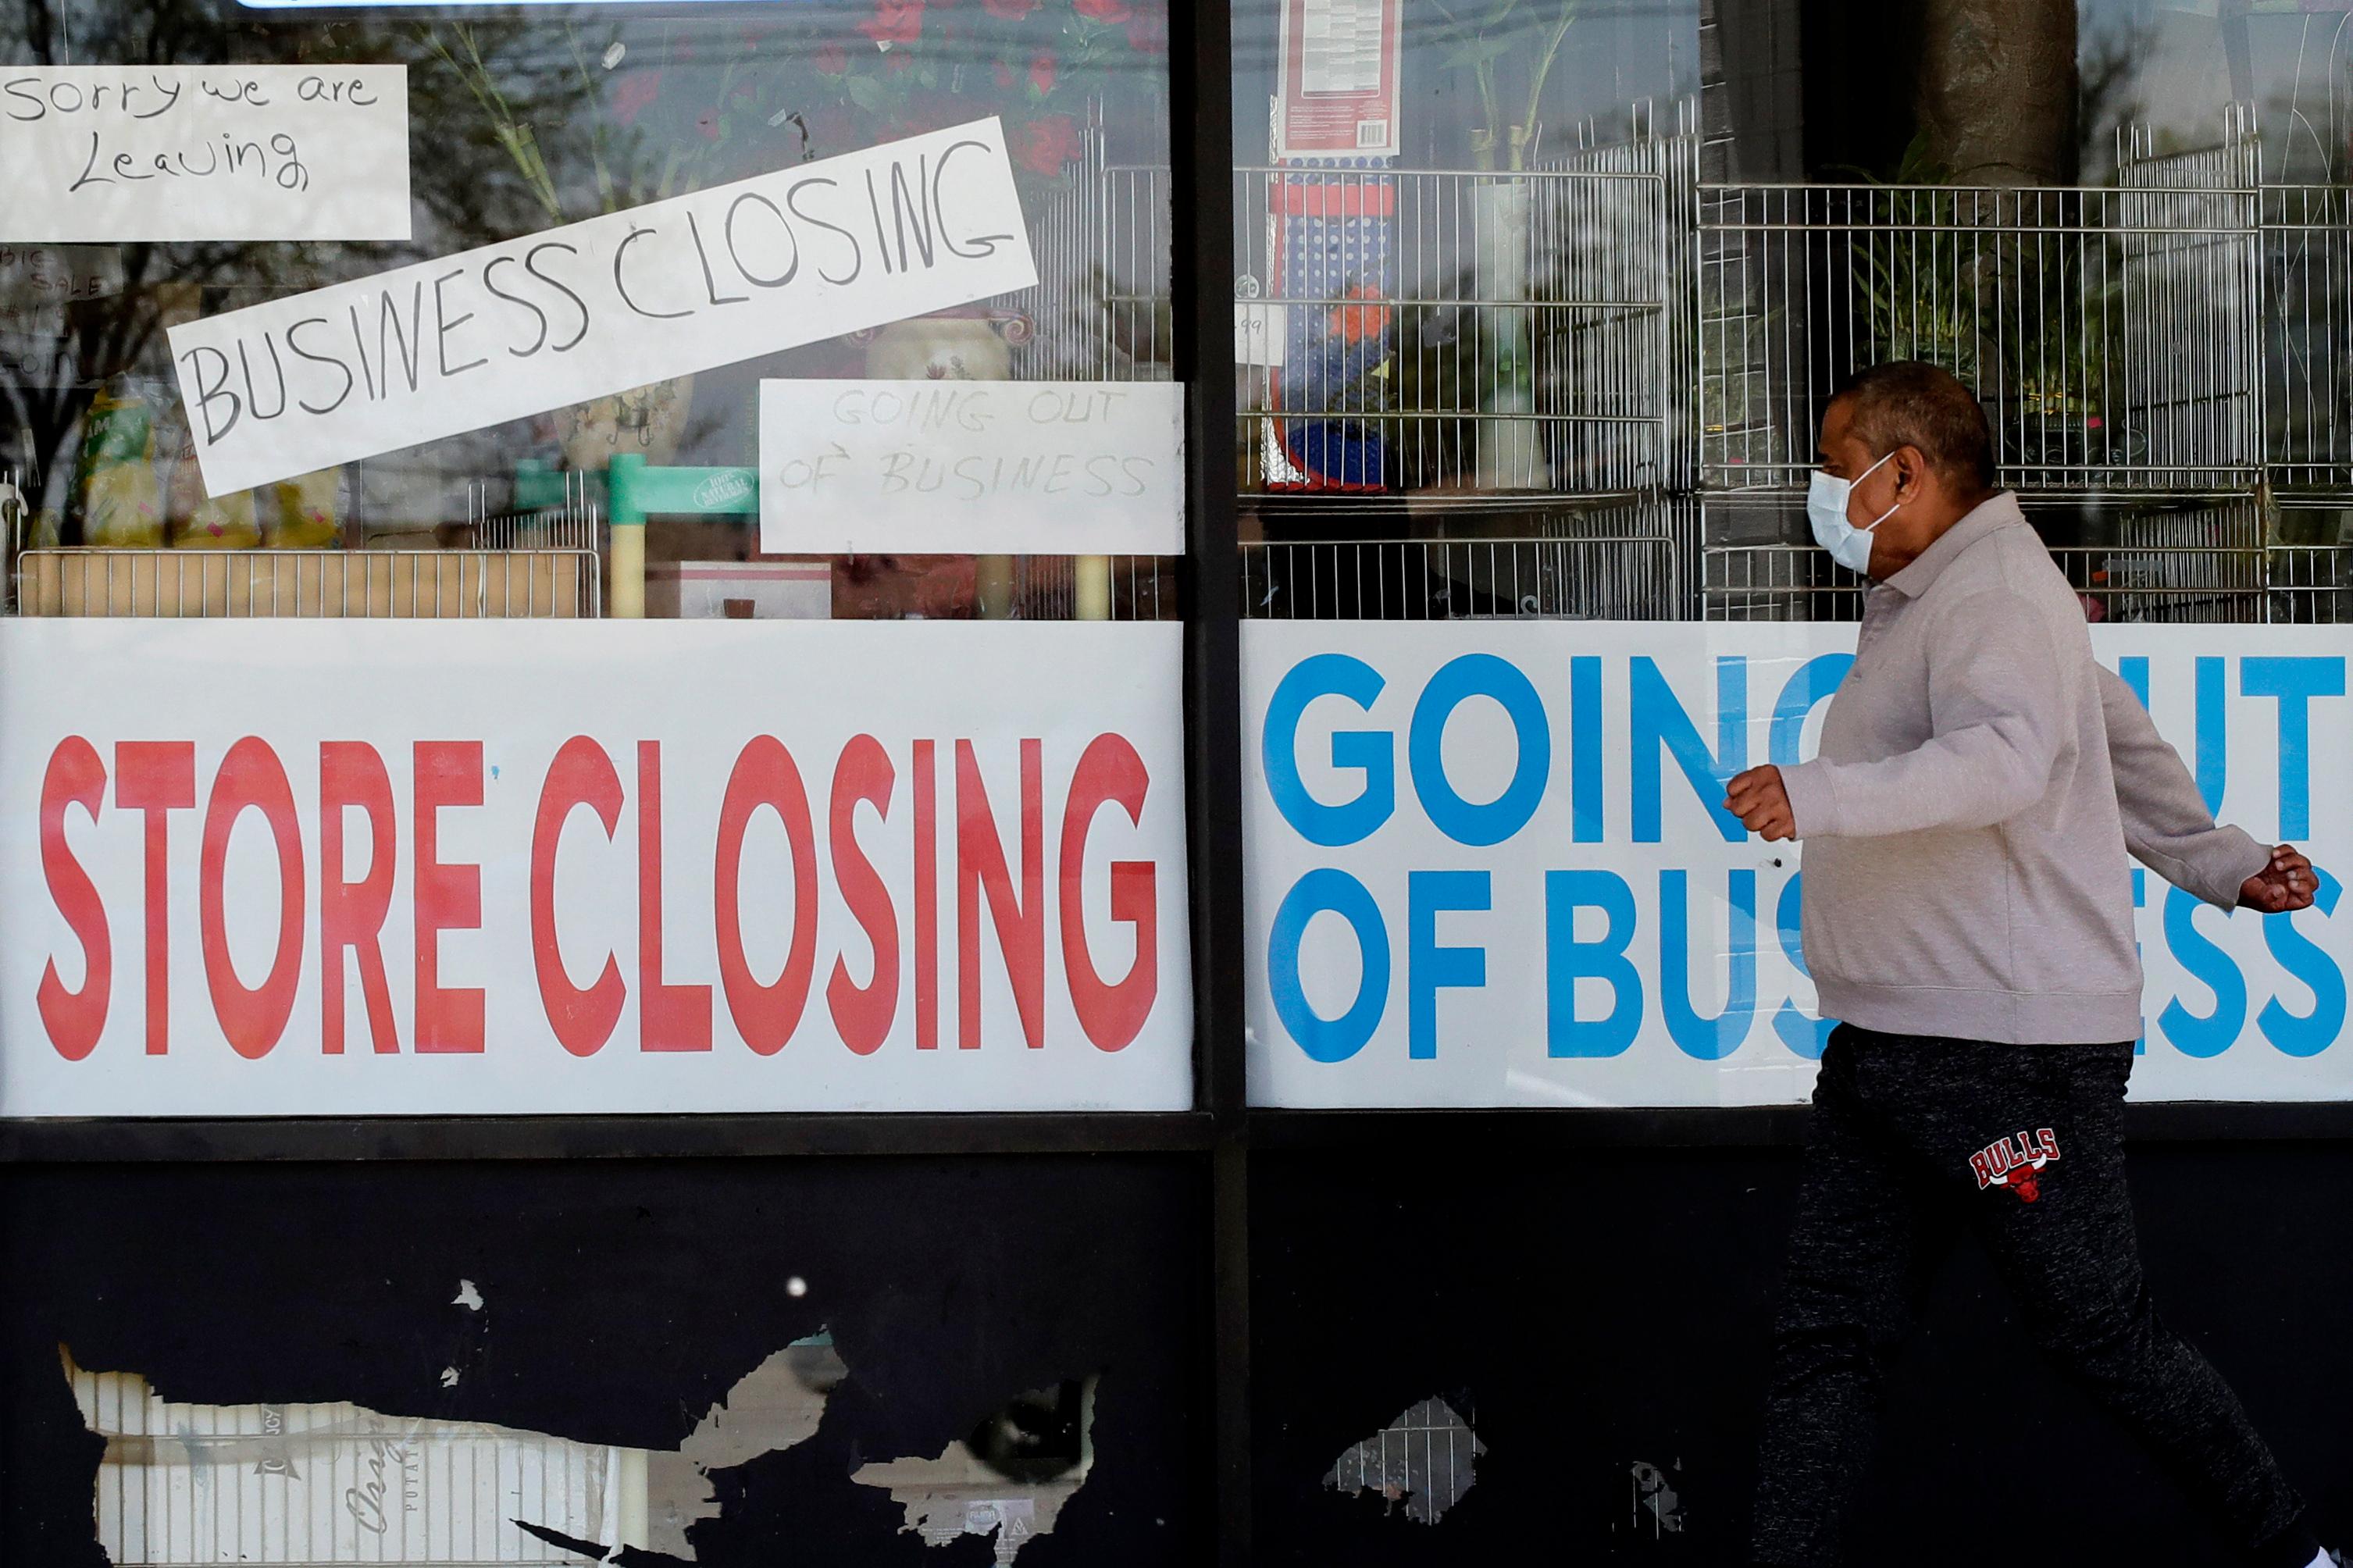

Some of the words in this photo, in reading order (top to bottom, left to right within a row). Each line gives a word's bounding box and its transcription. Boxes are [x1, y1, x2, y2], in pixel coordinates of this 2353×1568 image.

[4, 75, 180, 120] Sorry
[201, 79, 269, 106] we
[298, 76, 378, 105] are
[70, 131, 309, 192] Leaving
[181, 243, 589, 446] BUSINESS
[615, 141, 1014, 318] CLOSING
[833, 390, 995, 433] GOING
[1028, 390, 1126, 423] OUT
[780, 447, 851, 494] OF
[880, 451, 1155, 501] BUSINESS
[2119, 656, 2344, 841] UT
[36, 735, 485, 1061] STORE
[530, 732, 1157, 1057] CLOSING
[1268, 868, 1491, 1063] OF
[1545, 865, 2346, 1060] BUSSS
[1969, 1128, 2060, 1190] BULLS
